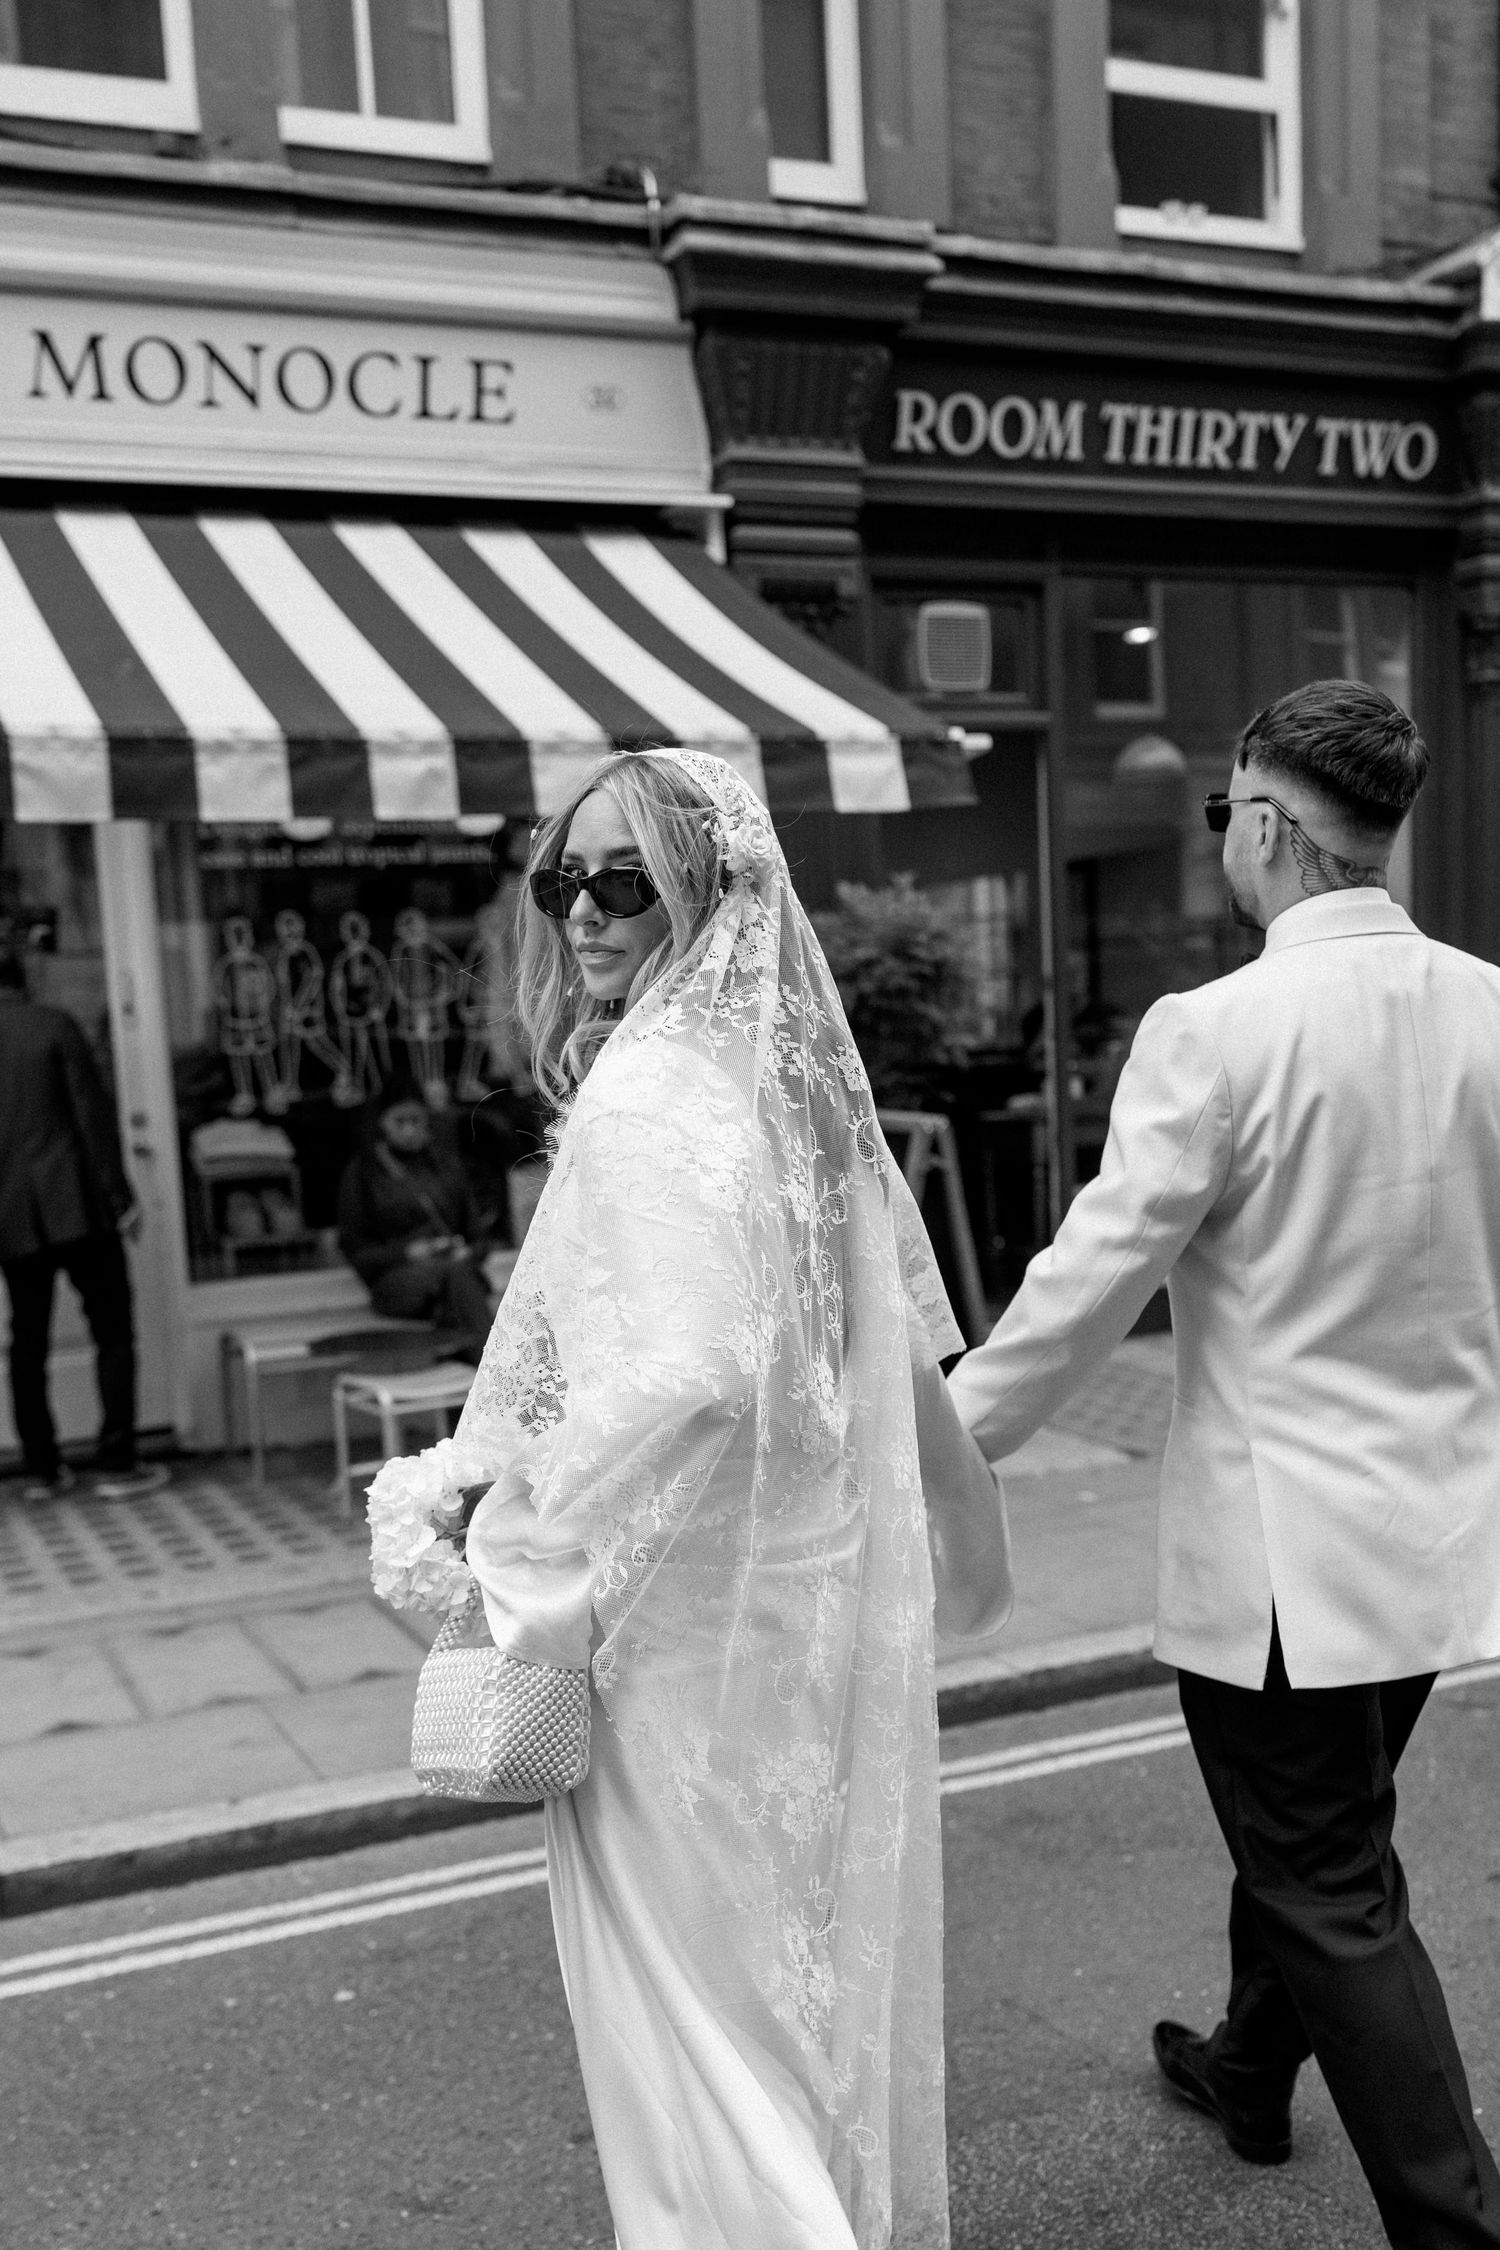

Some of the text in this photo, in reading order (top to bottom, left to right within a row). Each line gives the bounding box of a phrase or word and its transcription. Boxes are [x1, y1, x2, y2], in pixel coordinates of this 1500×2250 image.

[27, 328, 517, 425] MONOCLE
[892, 388, 1438, 481] ROOM THIRTY TWO
